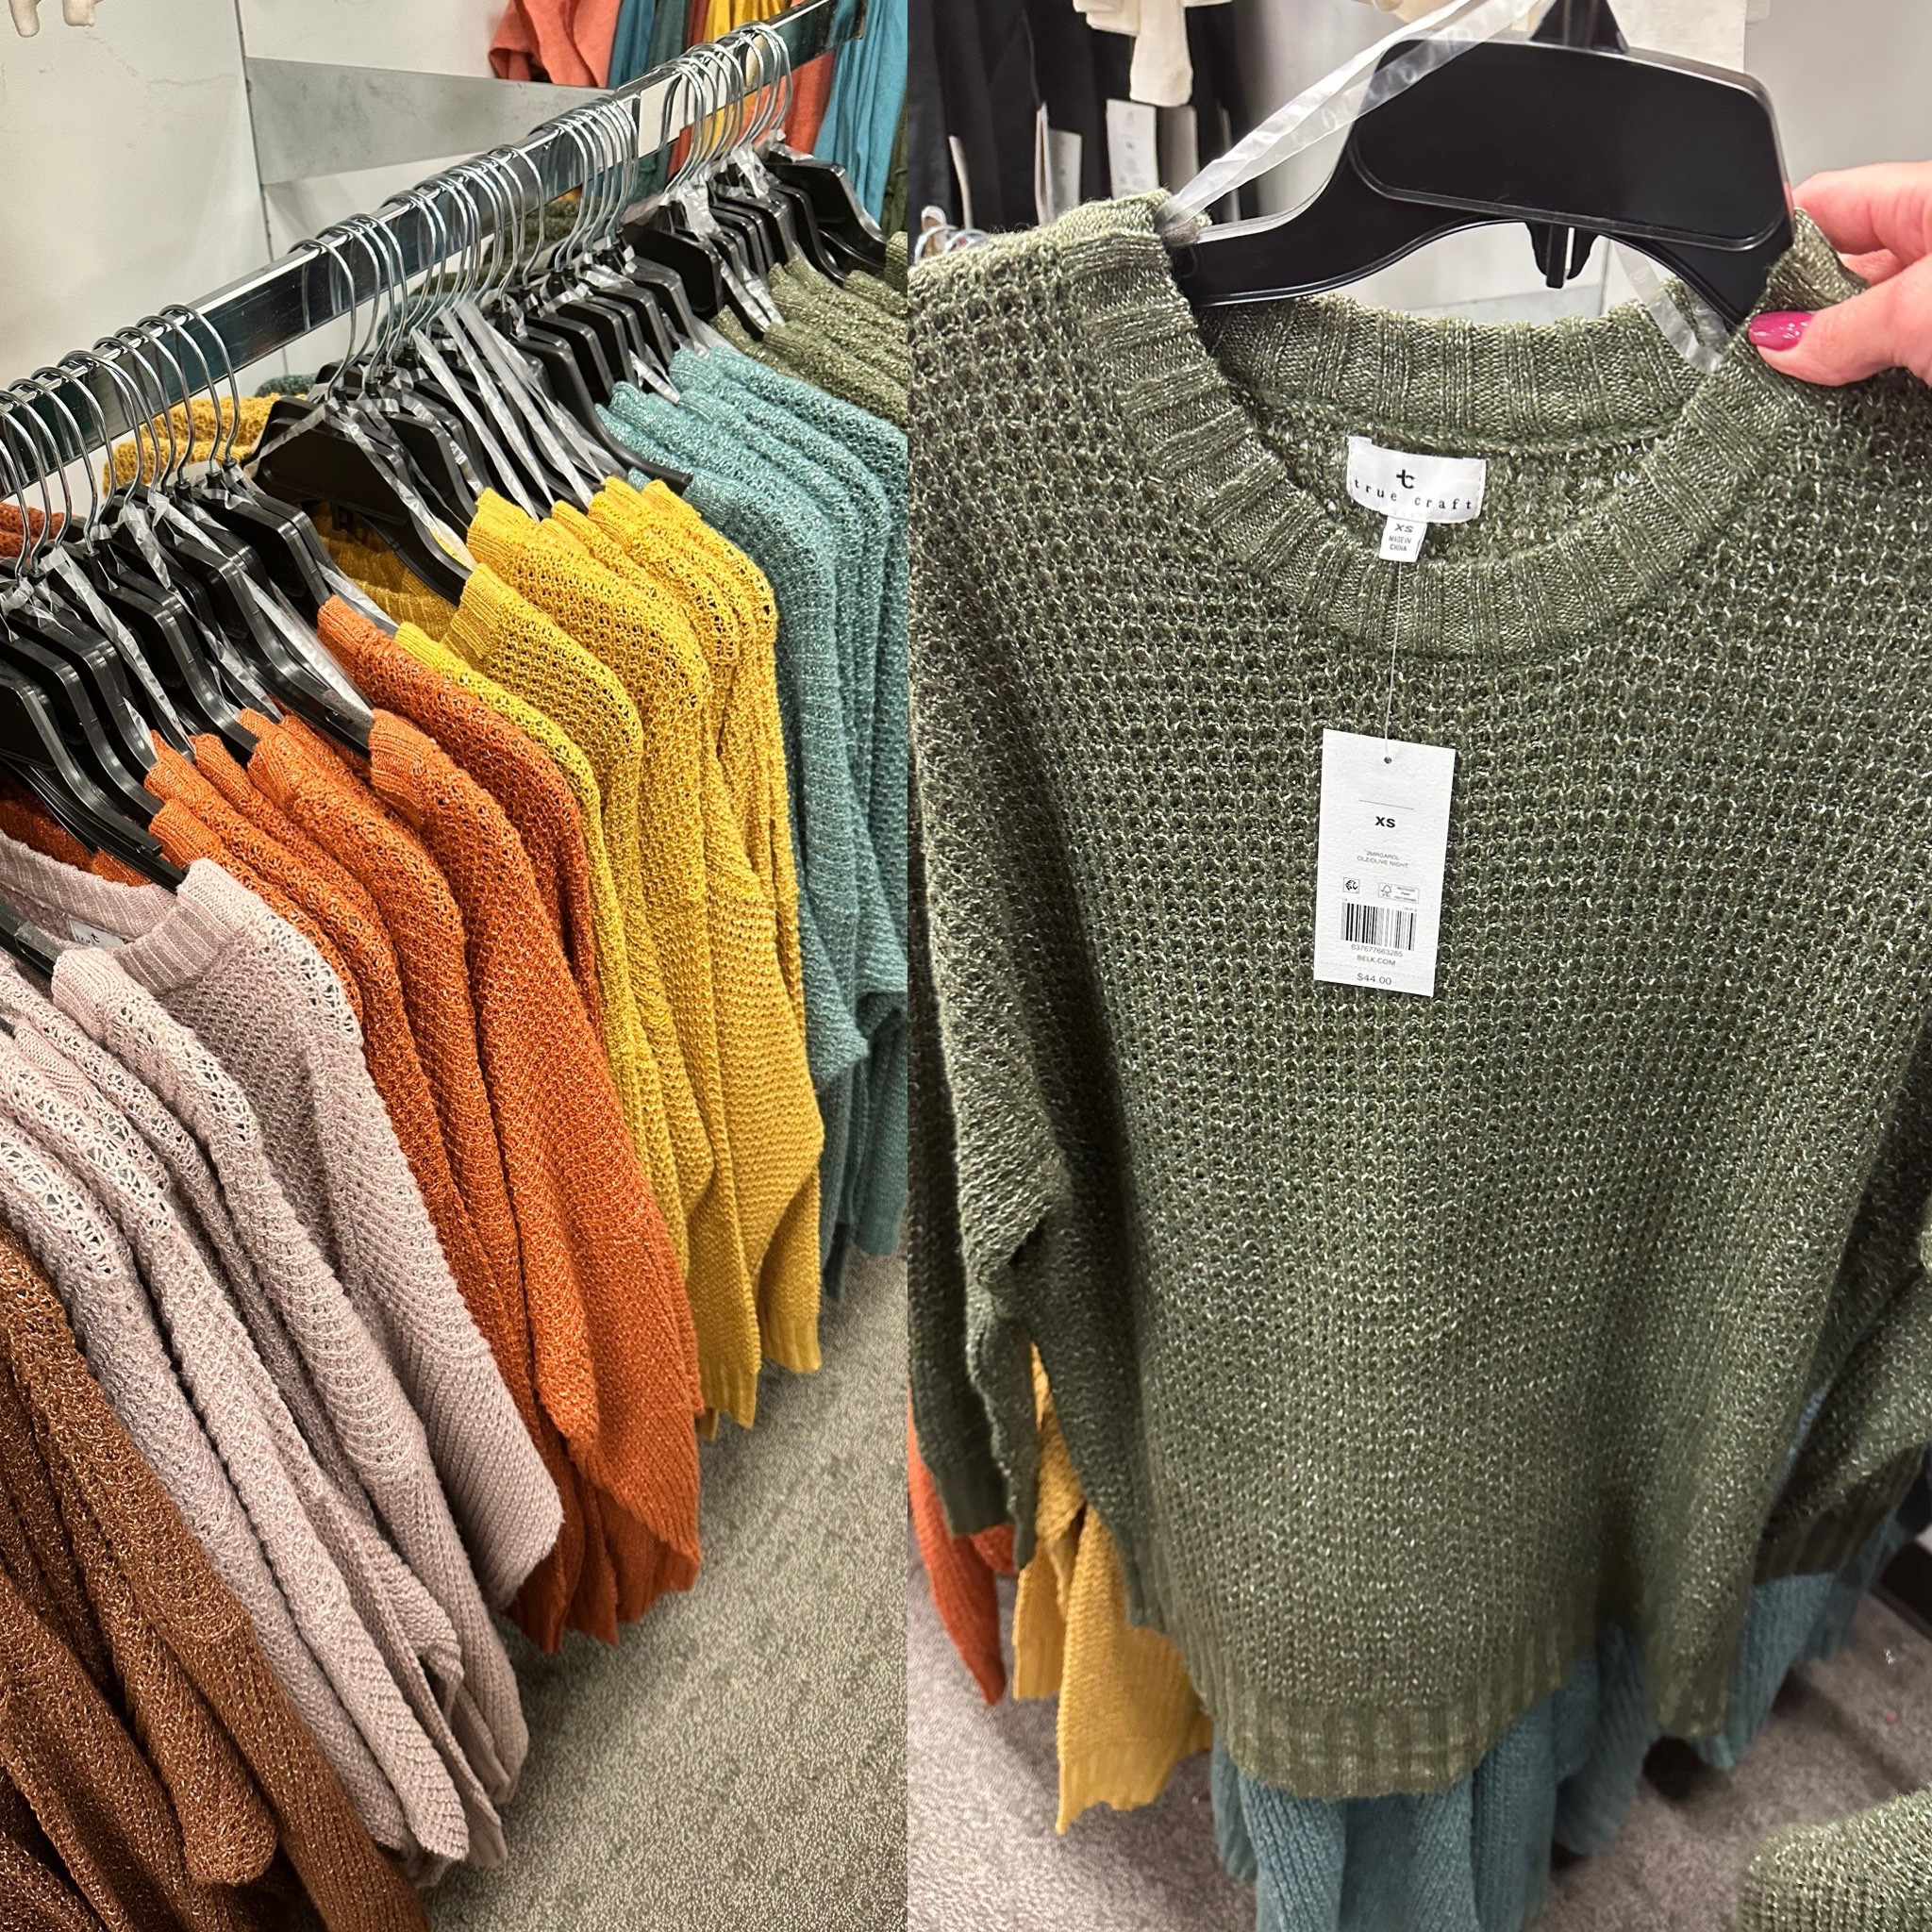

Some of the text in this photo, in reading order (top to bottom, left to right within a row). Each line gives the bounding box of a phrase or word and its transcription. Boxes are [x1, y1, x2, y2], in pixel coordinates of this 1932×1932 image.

[1355, 478, 1472, 510] true craft
[1394, 523, 1414, 534] XS
[1389, 535, 1406, 544] MADE
[1390, 543, 1407, 552] CHINA
[1374, 816, 1396, 828] XS
[1351, 943, 1404, 958] 637677663285
[1357, 954, 1396, 966] BELK.COM
[1357, 972, 1391, 986] $44.00
